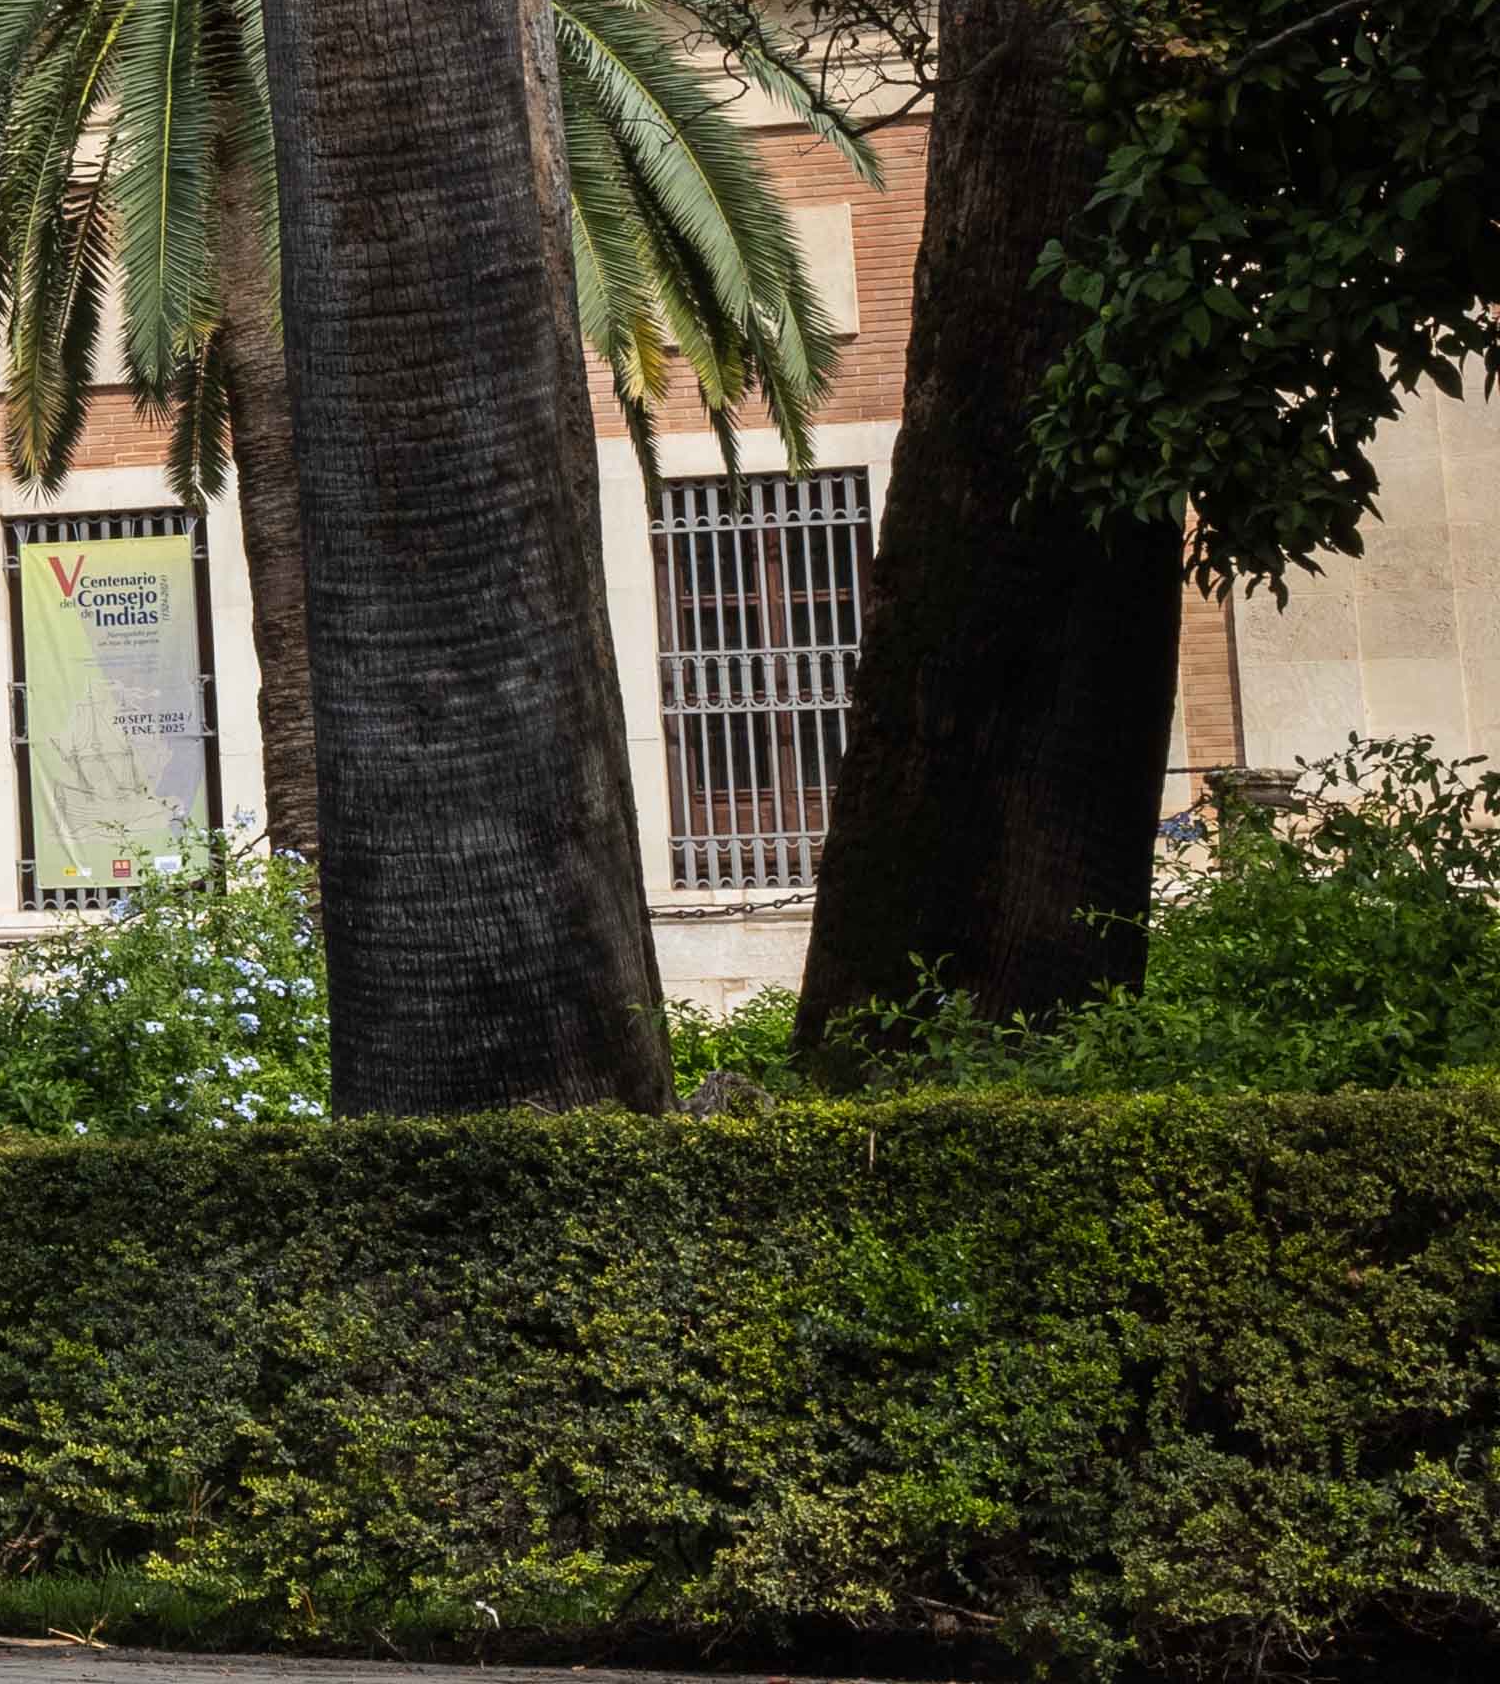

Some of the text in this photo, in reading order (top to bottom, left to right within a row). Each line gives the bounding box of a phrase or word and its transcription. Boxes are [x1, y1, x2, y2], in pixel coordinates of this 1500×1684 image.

[48, 554, 156, 598] V Centenario
[60, 586, 158, 609] del Consejo
[81, 606, 158, 627] de Indias
[113, 716, 125, 725] 20
[128, 714, 156, 724] SEPT.
[159, 712, 184, 722] 2024
[159, 723, 185, 733] 2025
